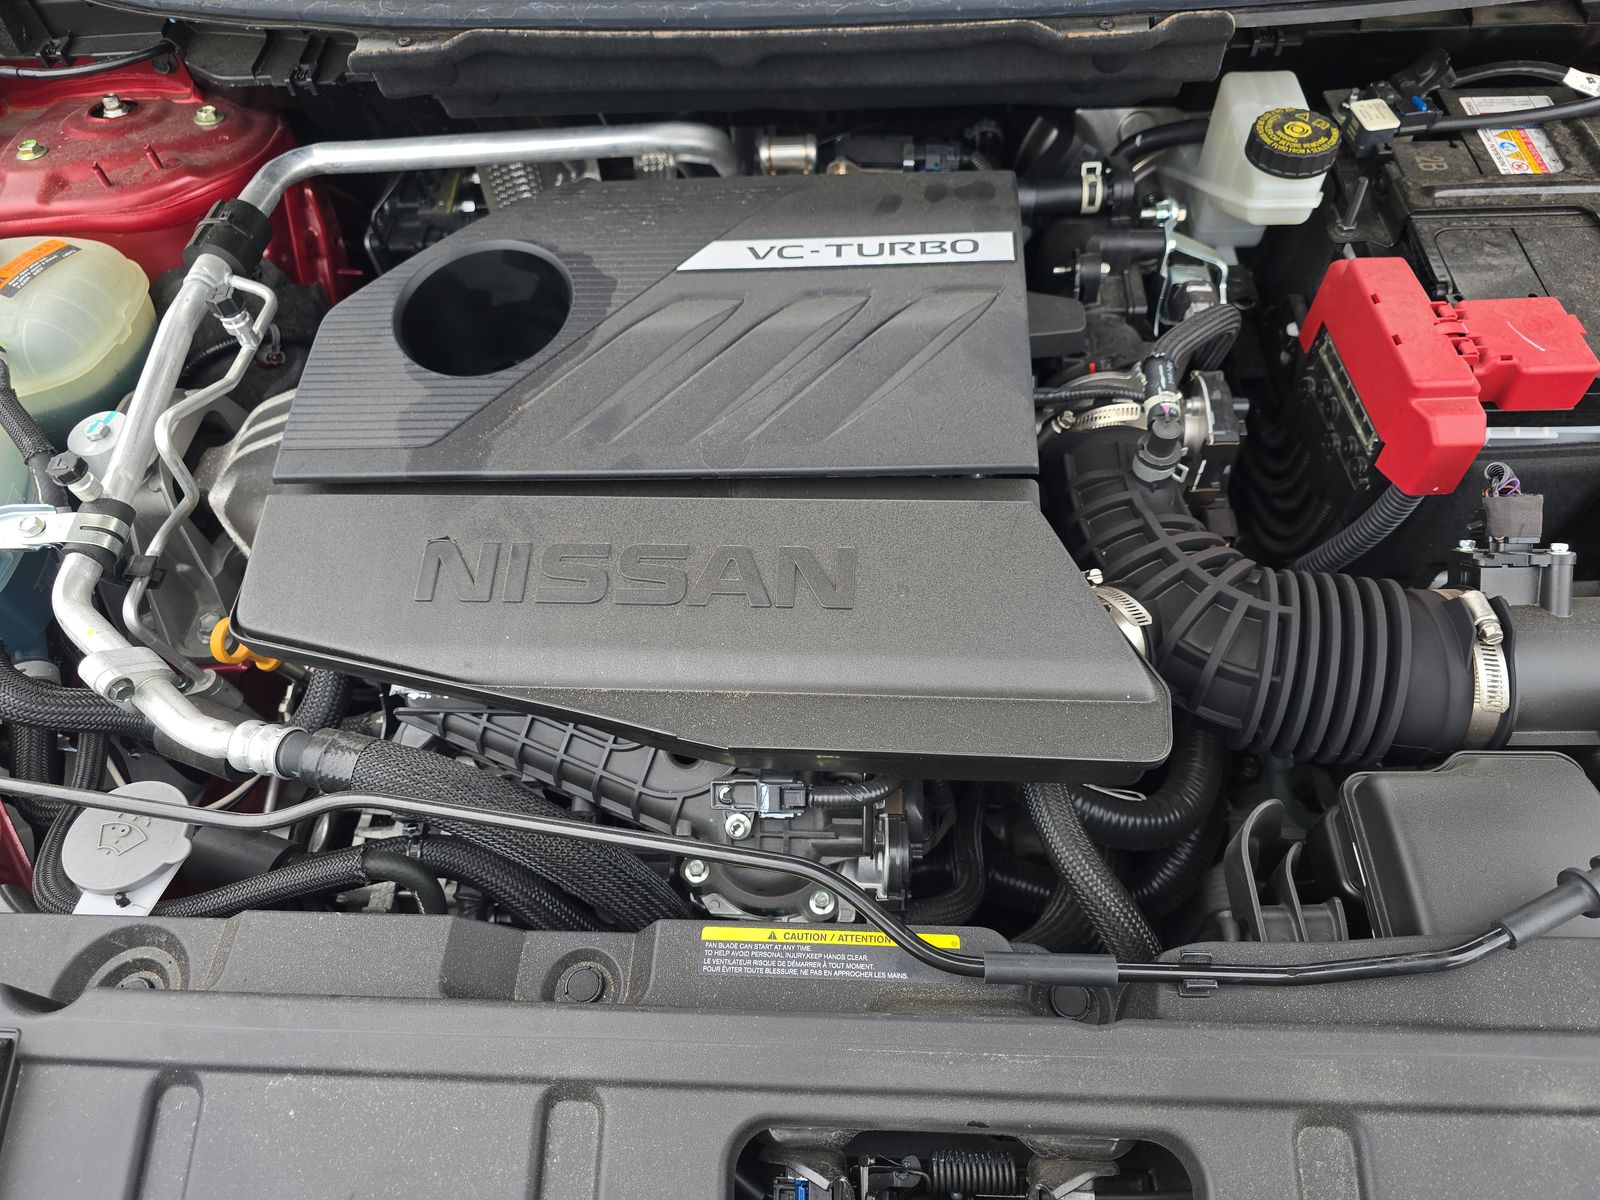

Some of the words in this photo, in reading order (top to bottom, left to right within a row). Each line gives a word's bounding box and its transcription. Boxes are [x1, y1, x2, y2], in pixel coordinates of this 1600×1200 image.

[747, 238, 980, 260] VC-TURBO
[414, 537, 856, 610] NISSAN
[783, 932, 827, 941] CAUTION
[830, 933, 835, 942] /
[838, 934, 892, 944] ATTENTION
[787, 960, 821, 968] DÉMARRER
